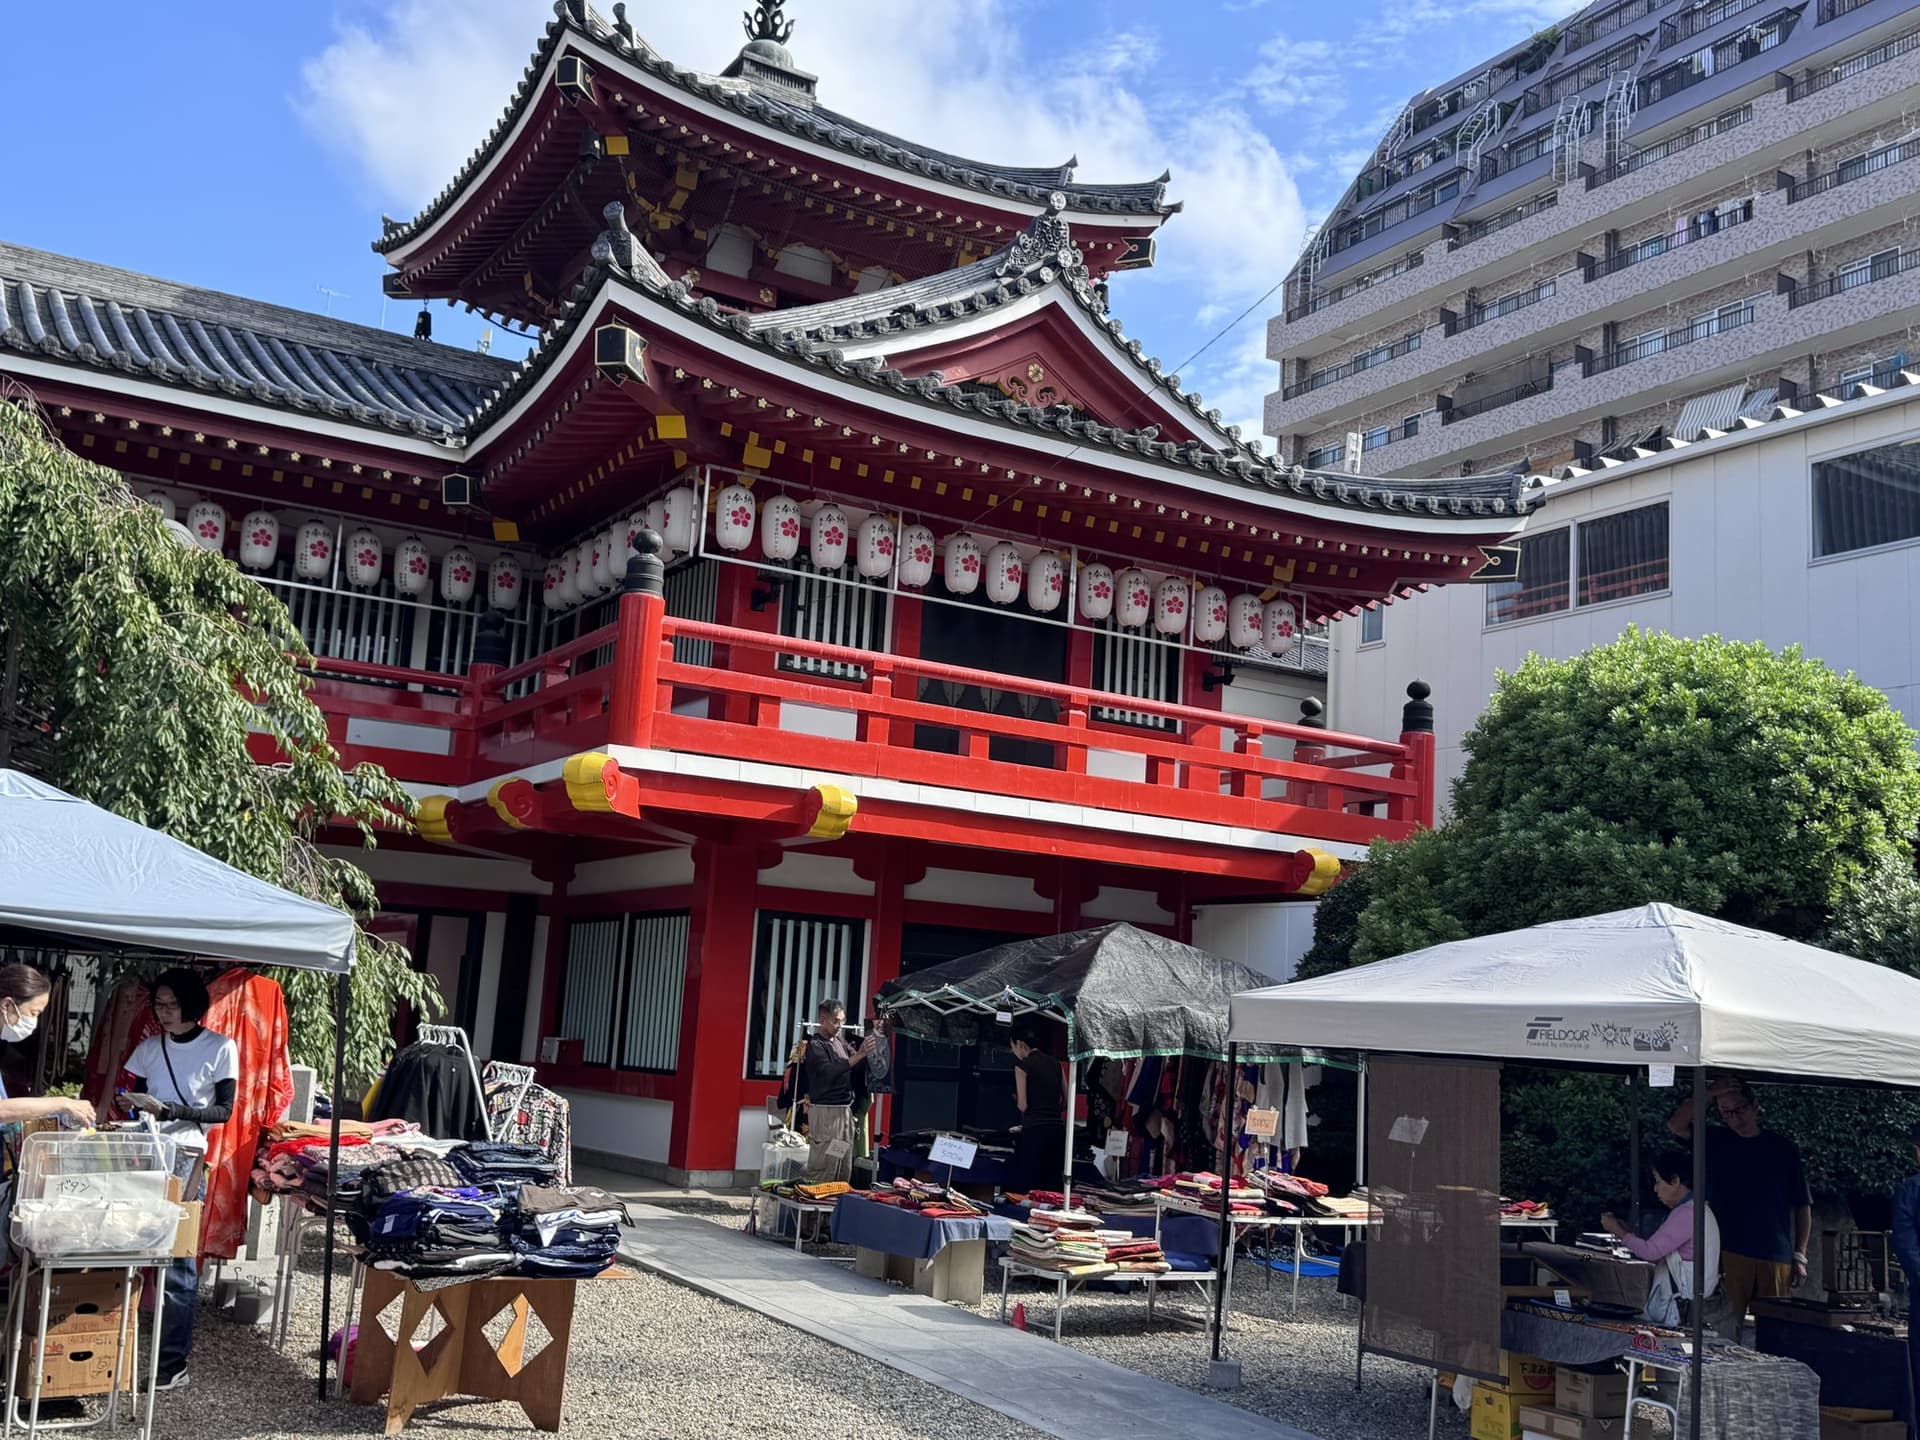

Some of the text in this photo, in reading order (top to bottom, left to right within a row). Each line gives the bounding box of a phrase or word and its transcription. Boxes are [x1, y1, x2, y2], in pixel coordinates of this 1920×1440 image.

[1539, 1028, 1589, 1041] FIELDOOR
[56, 1179, 91, 1193] ボタン
